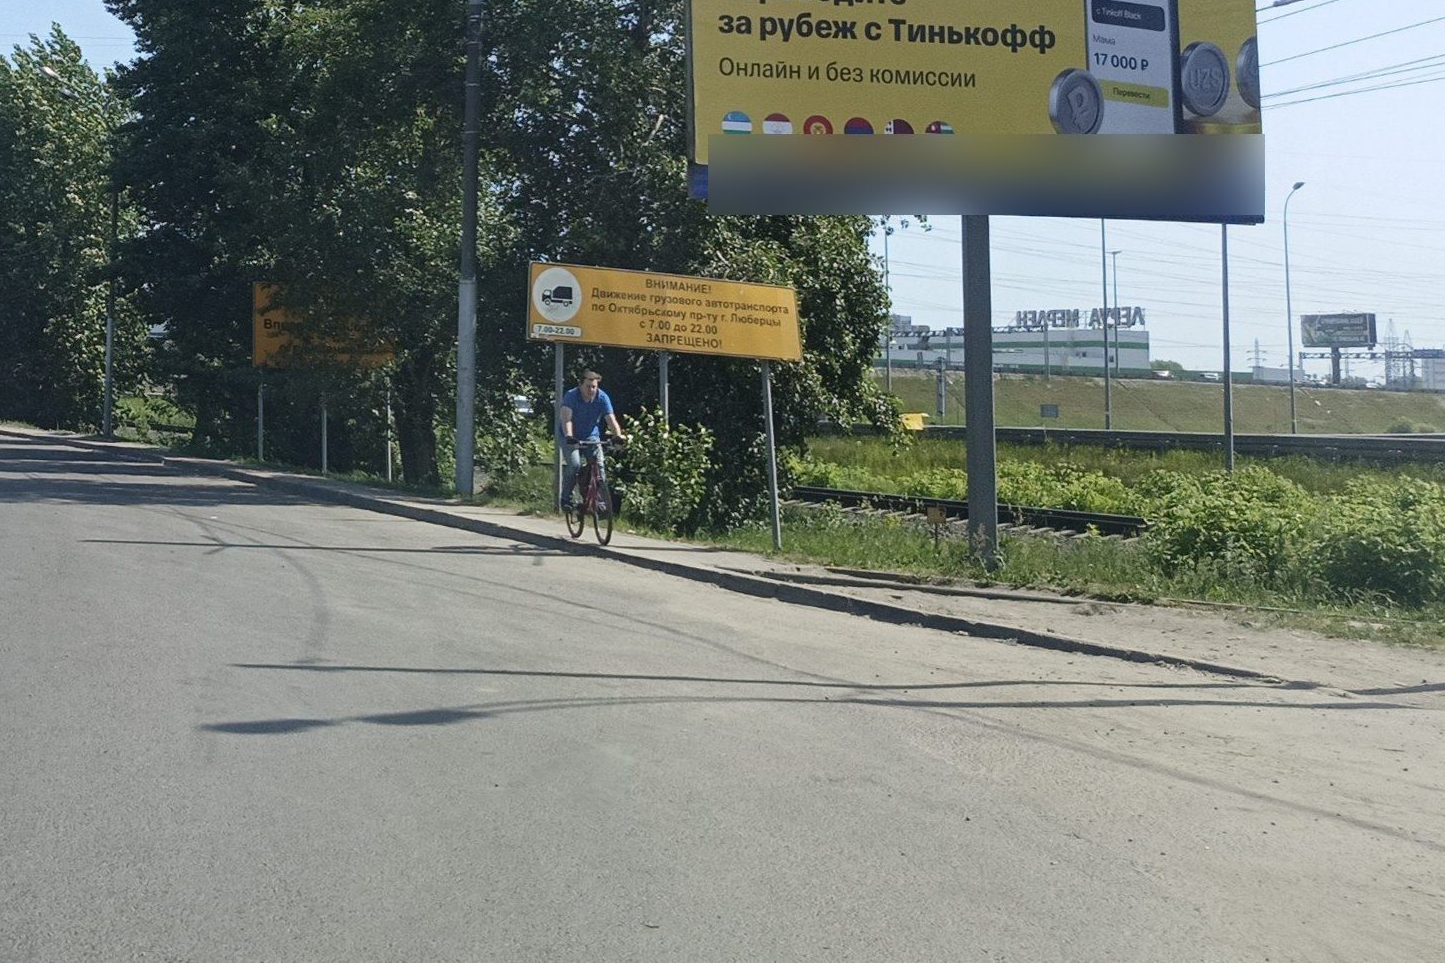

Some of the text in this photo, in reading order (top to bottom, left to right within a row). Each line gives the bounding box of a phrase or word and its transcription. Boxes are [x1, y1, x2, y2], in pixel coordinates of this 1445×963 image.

[718, 13, 1056, 54] за рубеж с Тинькофф
[1094, 52, 1108, 66] 17
[1110, 55, 1137, 70] 000
[719, 56, 976, 88] Онлайн и без комиссии
[645, 278, 712, 294] ВНИМАНИЕ!
[591, 287, 789, 315] Движение грузового автотранспорта
[591, 302, 781, 327] по Октябрьскому пр-ту г. Люберцы
[537, 325, 575, 335] 7.00-22.00
[639, 319, 718, 335] с 7.00 до 22.00
[646, 332, 723, 349] ЗАПРЕЩЕНО!
